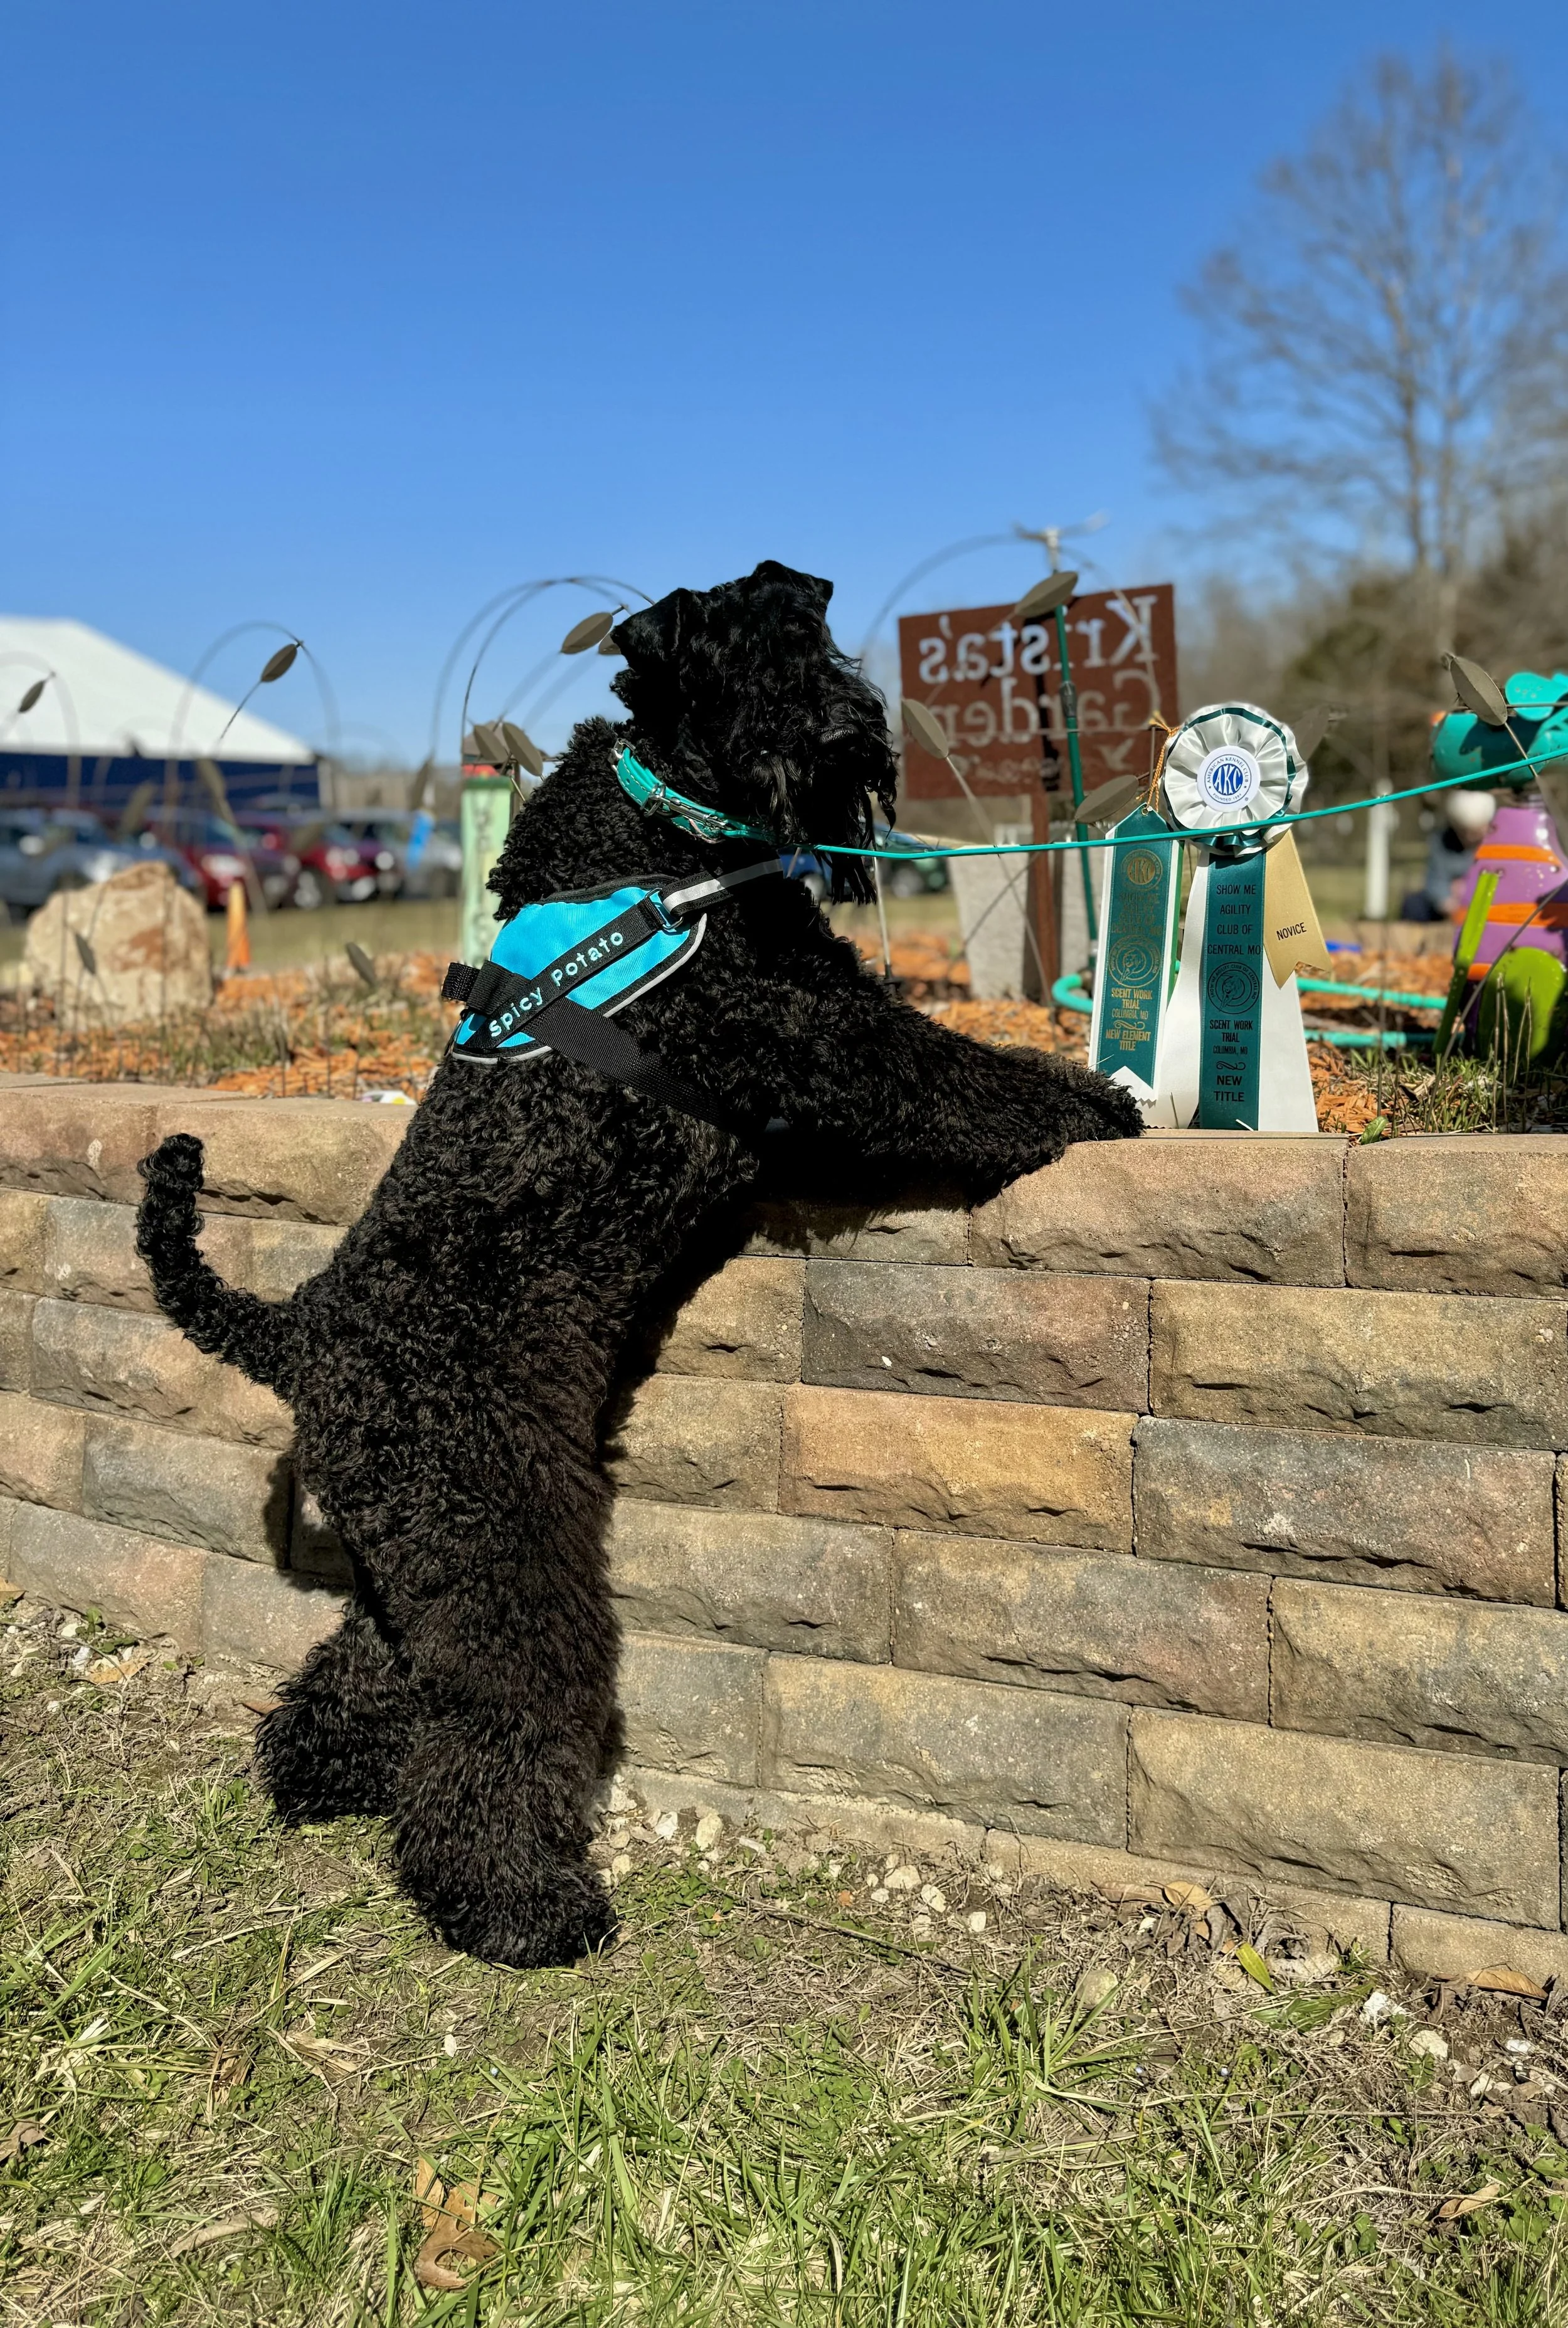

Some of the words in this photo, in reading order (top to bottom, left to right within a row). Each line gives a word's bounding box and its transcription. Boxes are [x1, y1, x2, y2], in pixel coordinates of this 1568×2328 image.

[1207, 758, 1224, 783] AMERICAN
[1226, 757, 1244, 767] KENNEL
[1213, 764, 1242, 795] AKC
[1216, 884, 1241, 894] SHOW
[1244, 884, 1256, 894] ME
[1220, 904, 1251, 914] AGILITY
[1217, 924, 1238, 934] CLUB
[1242, 924, 1253, 934] OF
[1276, 922, 1307, 941] NOVICE
[1207, 944, 1244, 955] CENTRAL
[1248, 944, 1261, 955] MO
[489, 987, 543, 1037] Spicy
[551, 932, 623, 987] Potato
[1111, 988, 1131, 998] SCENT
[1133, 989, 1153, 1000] WORK
[1122, 999, 1140, 1009] TRIAL
[1140, 1010, 1148, 1019] MO
[1210, 1020, 1231, 1030] SCENT
[1234, 1020, 1253, 1030] WORK
[1106, 1029, 1121, 1039] NEW
[1121, 1030, 1152, 1041] ELEMENT
[1222, 1032, 1240, 1042] TRIAL
[1120, 1040, 1136, 1050] TITLE
[1213, 1045, 1238, 1056] COLUMBIA,
[1240, 1046, 1248, 1055] MO
[1217, 1075, 1242, 1086] NEW
[1214, 1091, 1245, 1102] TITLE
